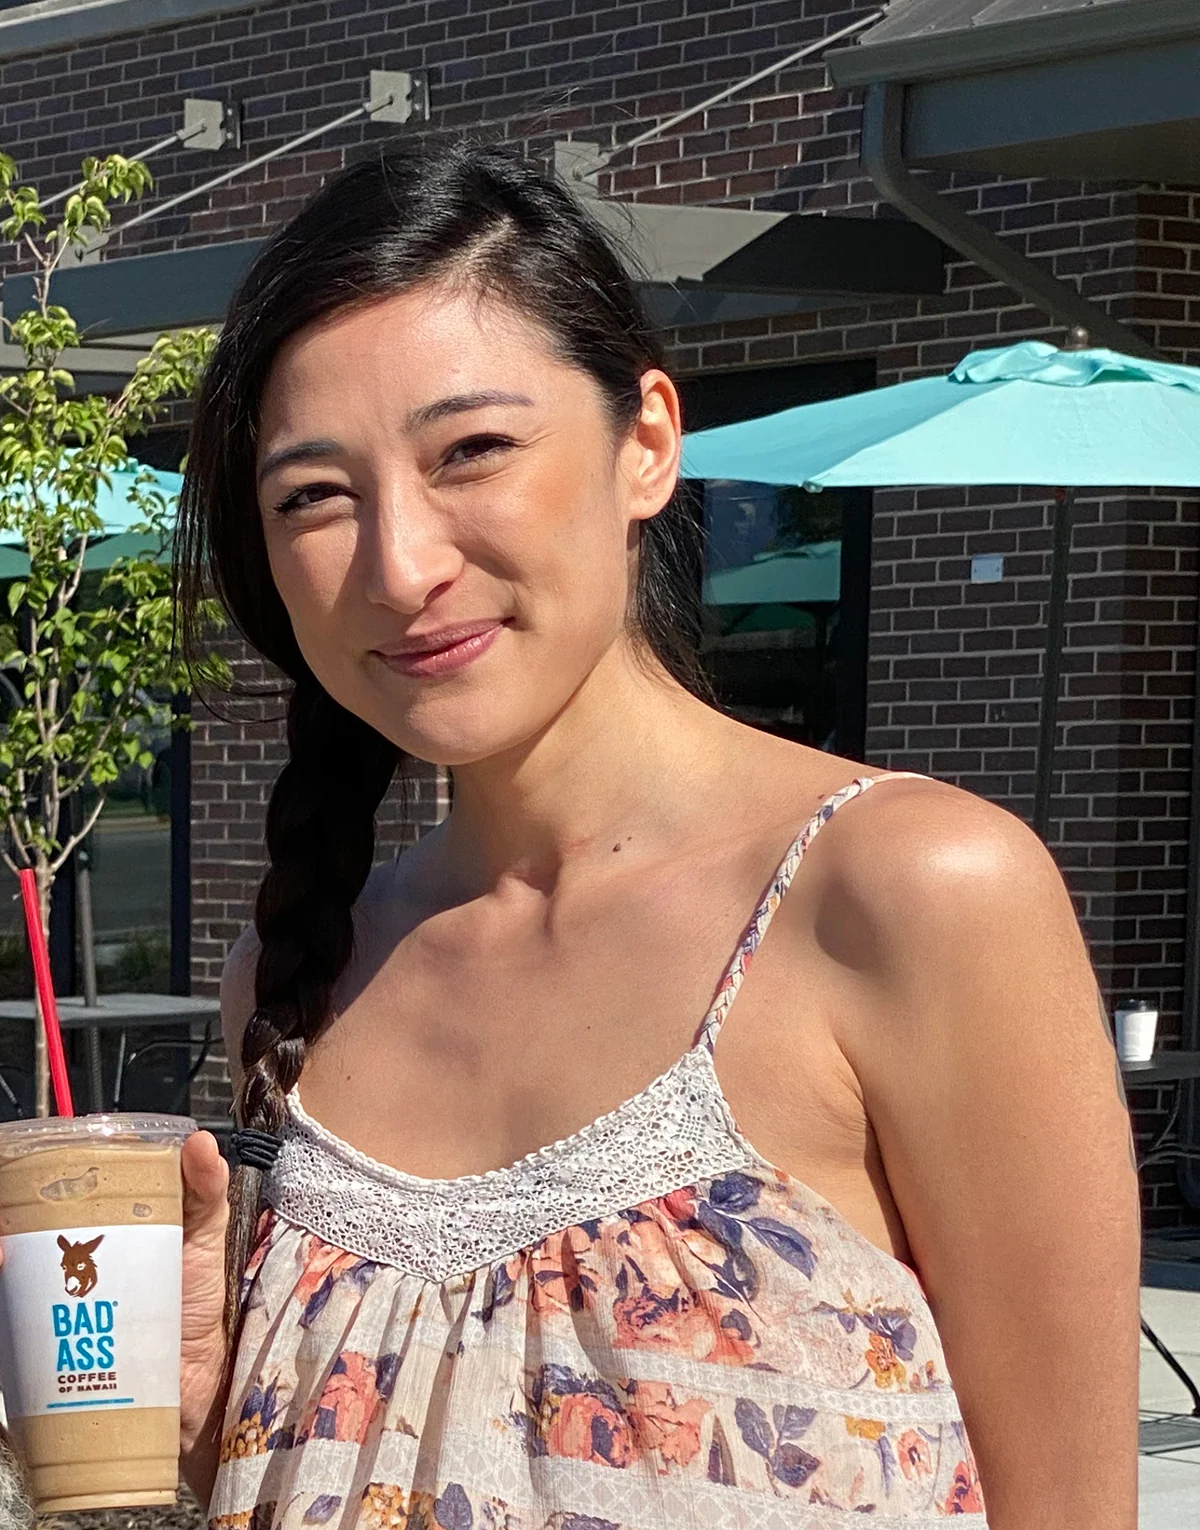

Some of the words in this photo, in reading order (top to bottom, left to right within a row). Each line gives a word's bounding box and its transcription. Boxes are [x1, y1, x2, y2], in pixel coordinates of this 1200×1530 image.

[52, 1300, 113, 1337] BAD
[57, 1335, 114, 1371] ASS
[57, 1371, 117, 1384] COFFEE
[77, 1383, 117, 1392] HAWAII
